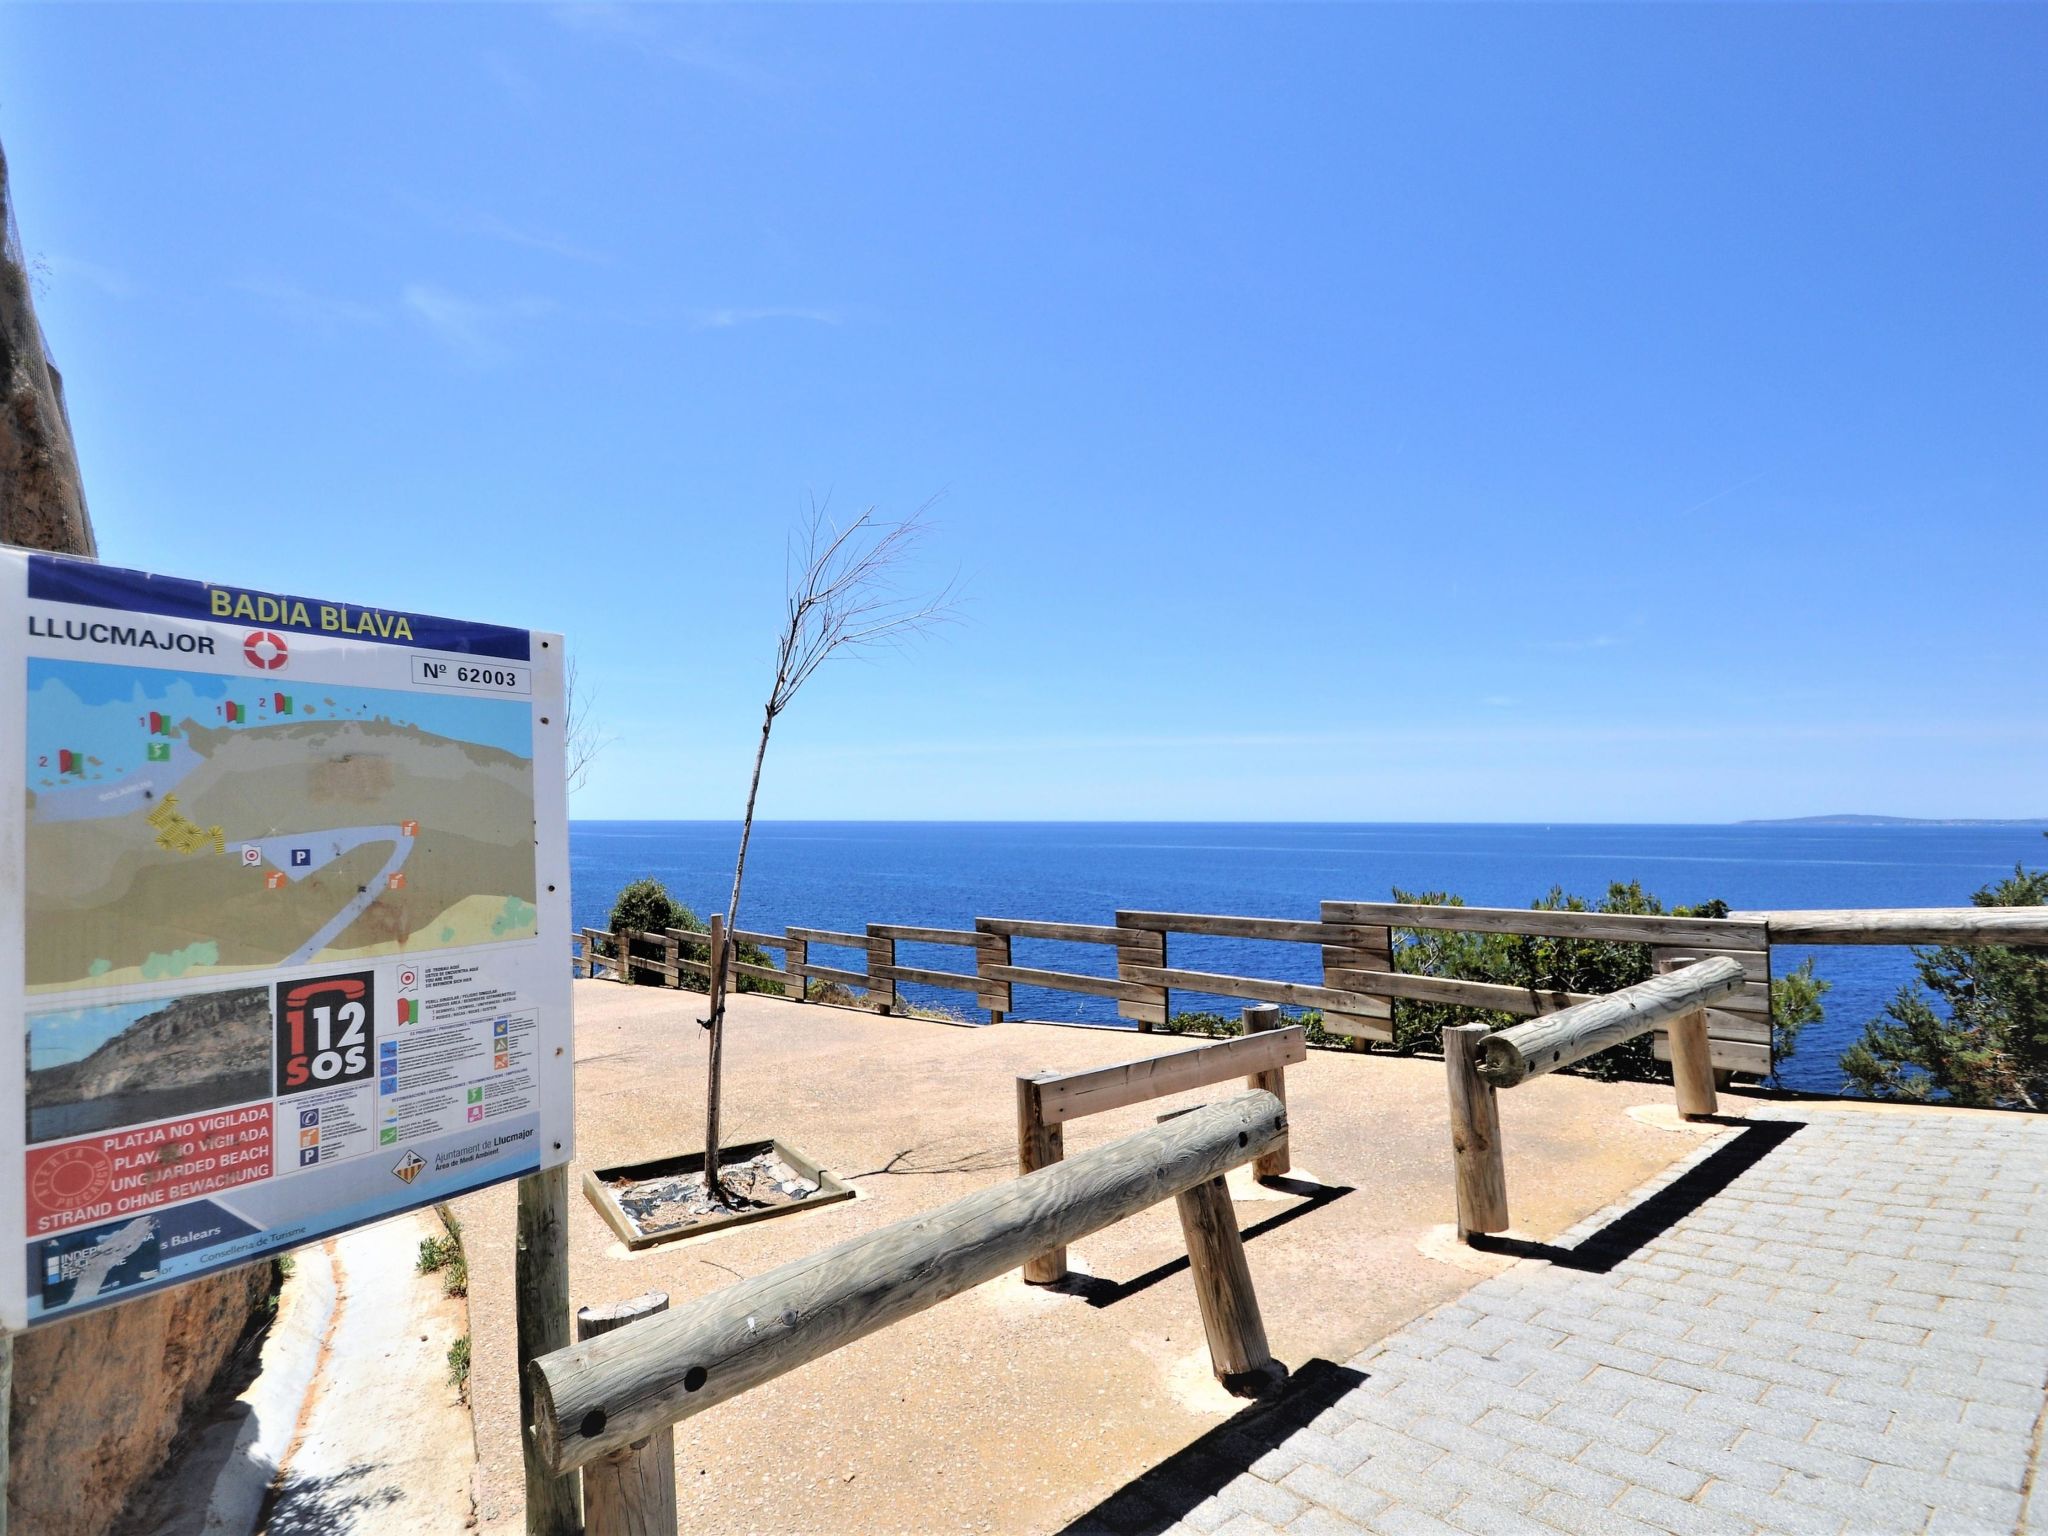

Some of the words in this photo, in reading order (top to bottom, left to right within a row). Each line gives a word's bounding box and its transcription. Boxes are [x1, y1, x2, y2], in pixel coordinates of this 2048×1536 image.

[210, 589, 312, 628] BADIA
[320, 605, 414, 641] BLAVA
[28, 615, 216, 655] LLUCMAJOR
[457, 667, 516, 687] 62003
[216, 705, 222, 716] 1
[258, 697, 267, 708] 2
[139, 716, 146, 728] 1
[39, 756, 49, 768] 2
[296, 850, 306, 864] P
[286, 1045, 367, 1086] SOS
[103, 1130, 166, 1153] PLATJA
[169, 1122, 195, 1139] NO
[198, 1107, 270, 1133] VIGILADA
[219, 1144, 269, 1168] BEACH
[304, 1149, 315, 1163] P
[434, 1143, 480, 1163] Ajuntament
[493, 1128, 534, 1147] Llucmajor
[38, 1202, 112, 1232] STRAND
[117, 1189, 165, 1212] OHNE
[169, 1163, 270, 1198] BEWACHUNG
[171, 1226, 222, 1247] Balears
